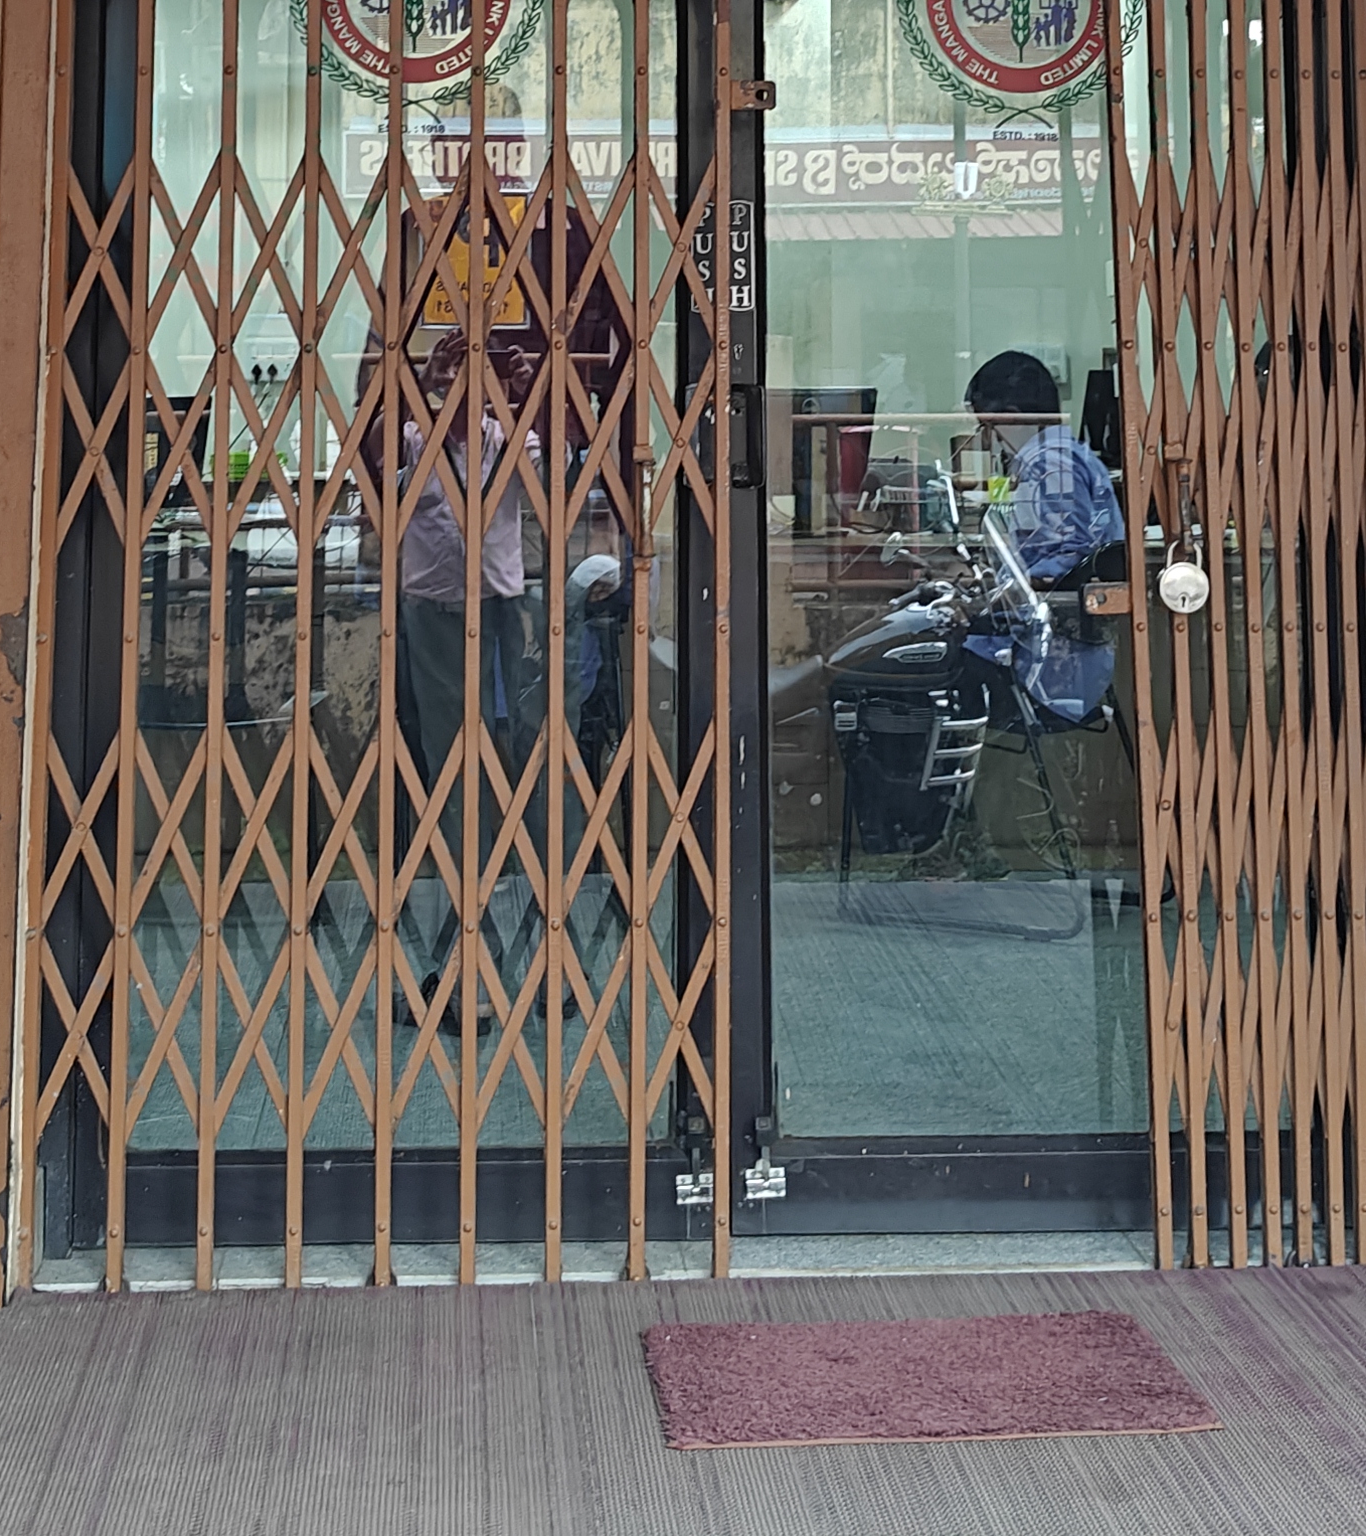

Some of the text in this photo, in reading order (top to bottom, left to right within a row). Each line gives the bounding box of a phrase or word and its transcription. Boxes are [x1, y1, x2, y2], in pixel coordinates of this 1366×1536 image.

[964, 58, 1000, 85] THE
[1038, 37, 1097, 85] LIMITED
[730, 203, 751, 307] PUSH
